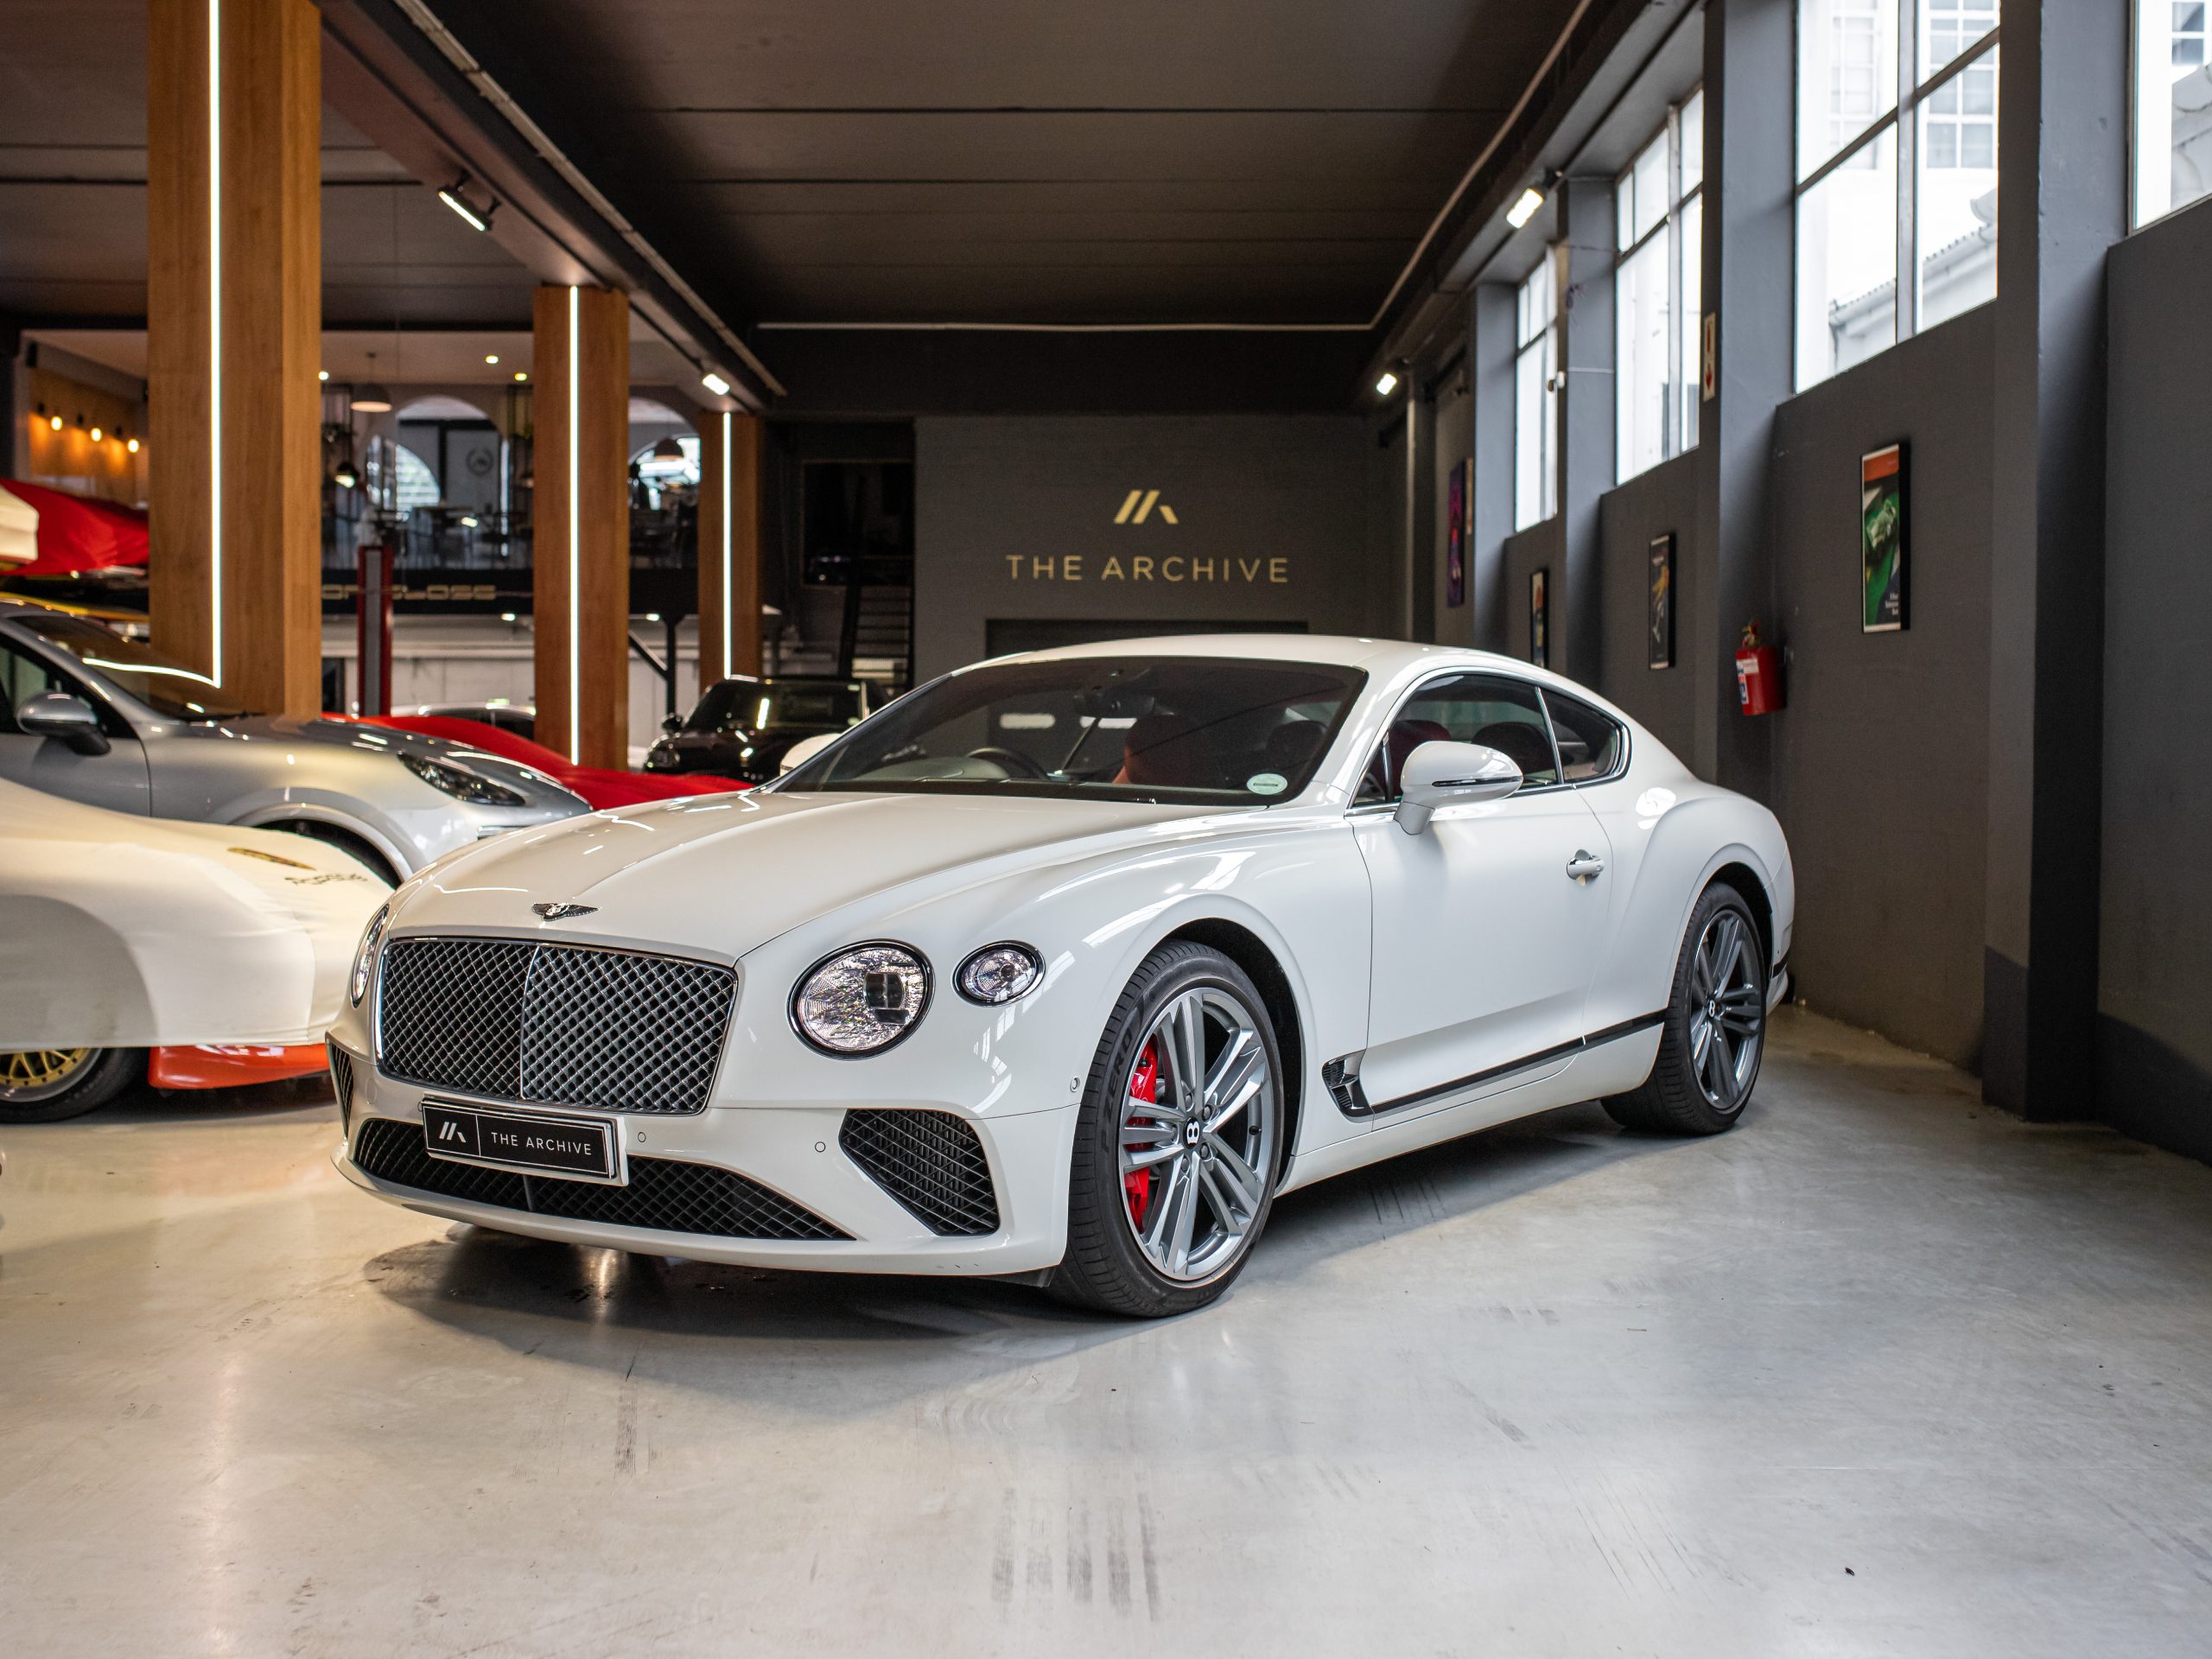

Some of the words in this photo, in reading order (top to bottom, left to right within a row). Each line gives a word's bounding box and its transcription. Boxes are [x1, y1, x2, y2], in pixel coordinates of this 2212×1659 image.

[1005, 554, 1084, 582] THE
[1100, 555, 1289, 583] ARCHIVE
[1103, 1027, 1133, 1122] ZERO
[491, 1131, 518, 1147] THE
[525, 1136, 592, 1155] ARCHIVE
[1186, 1121, 1200, 1145] B
